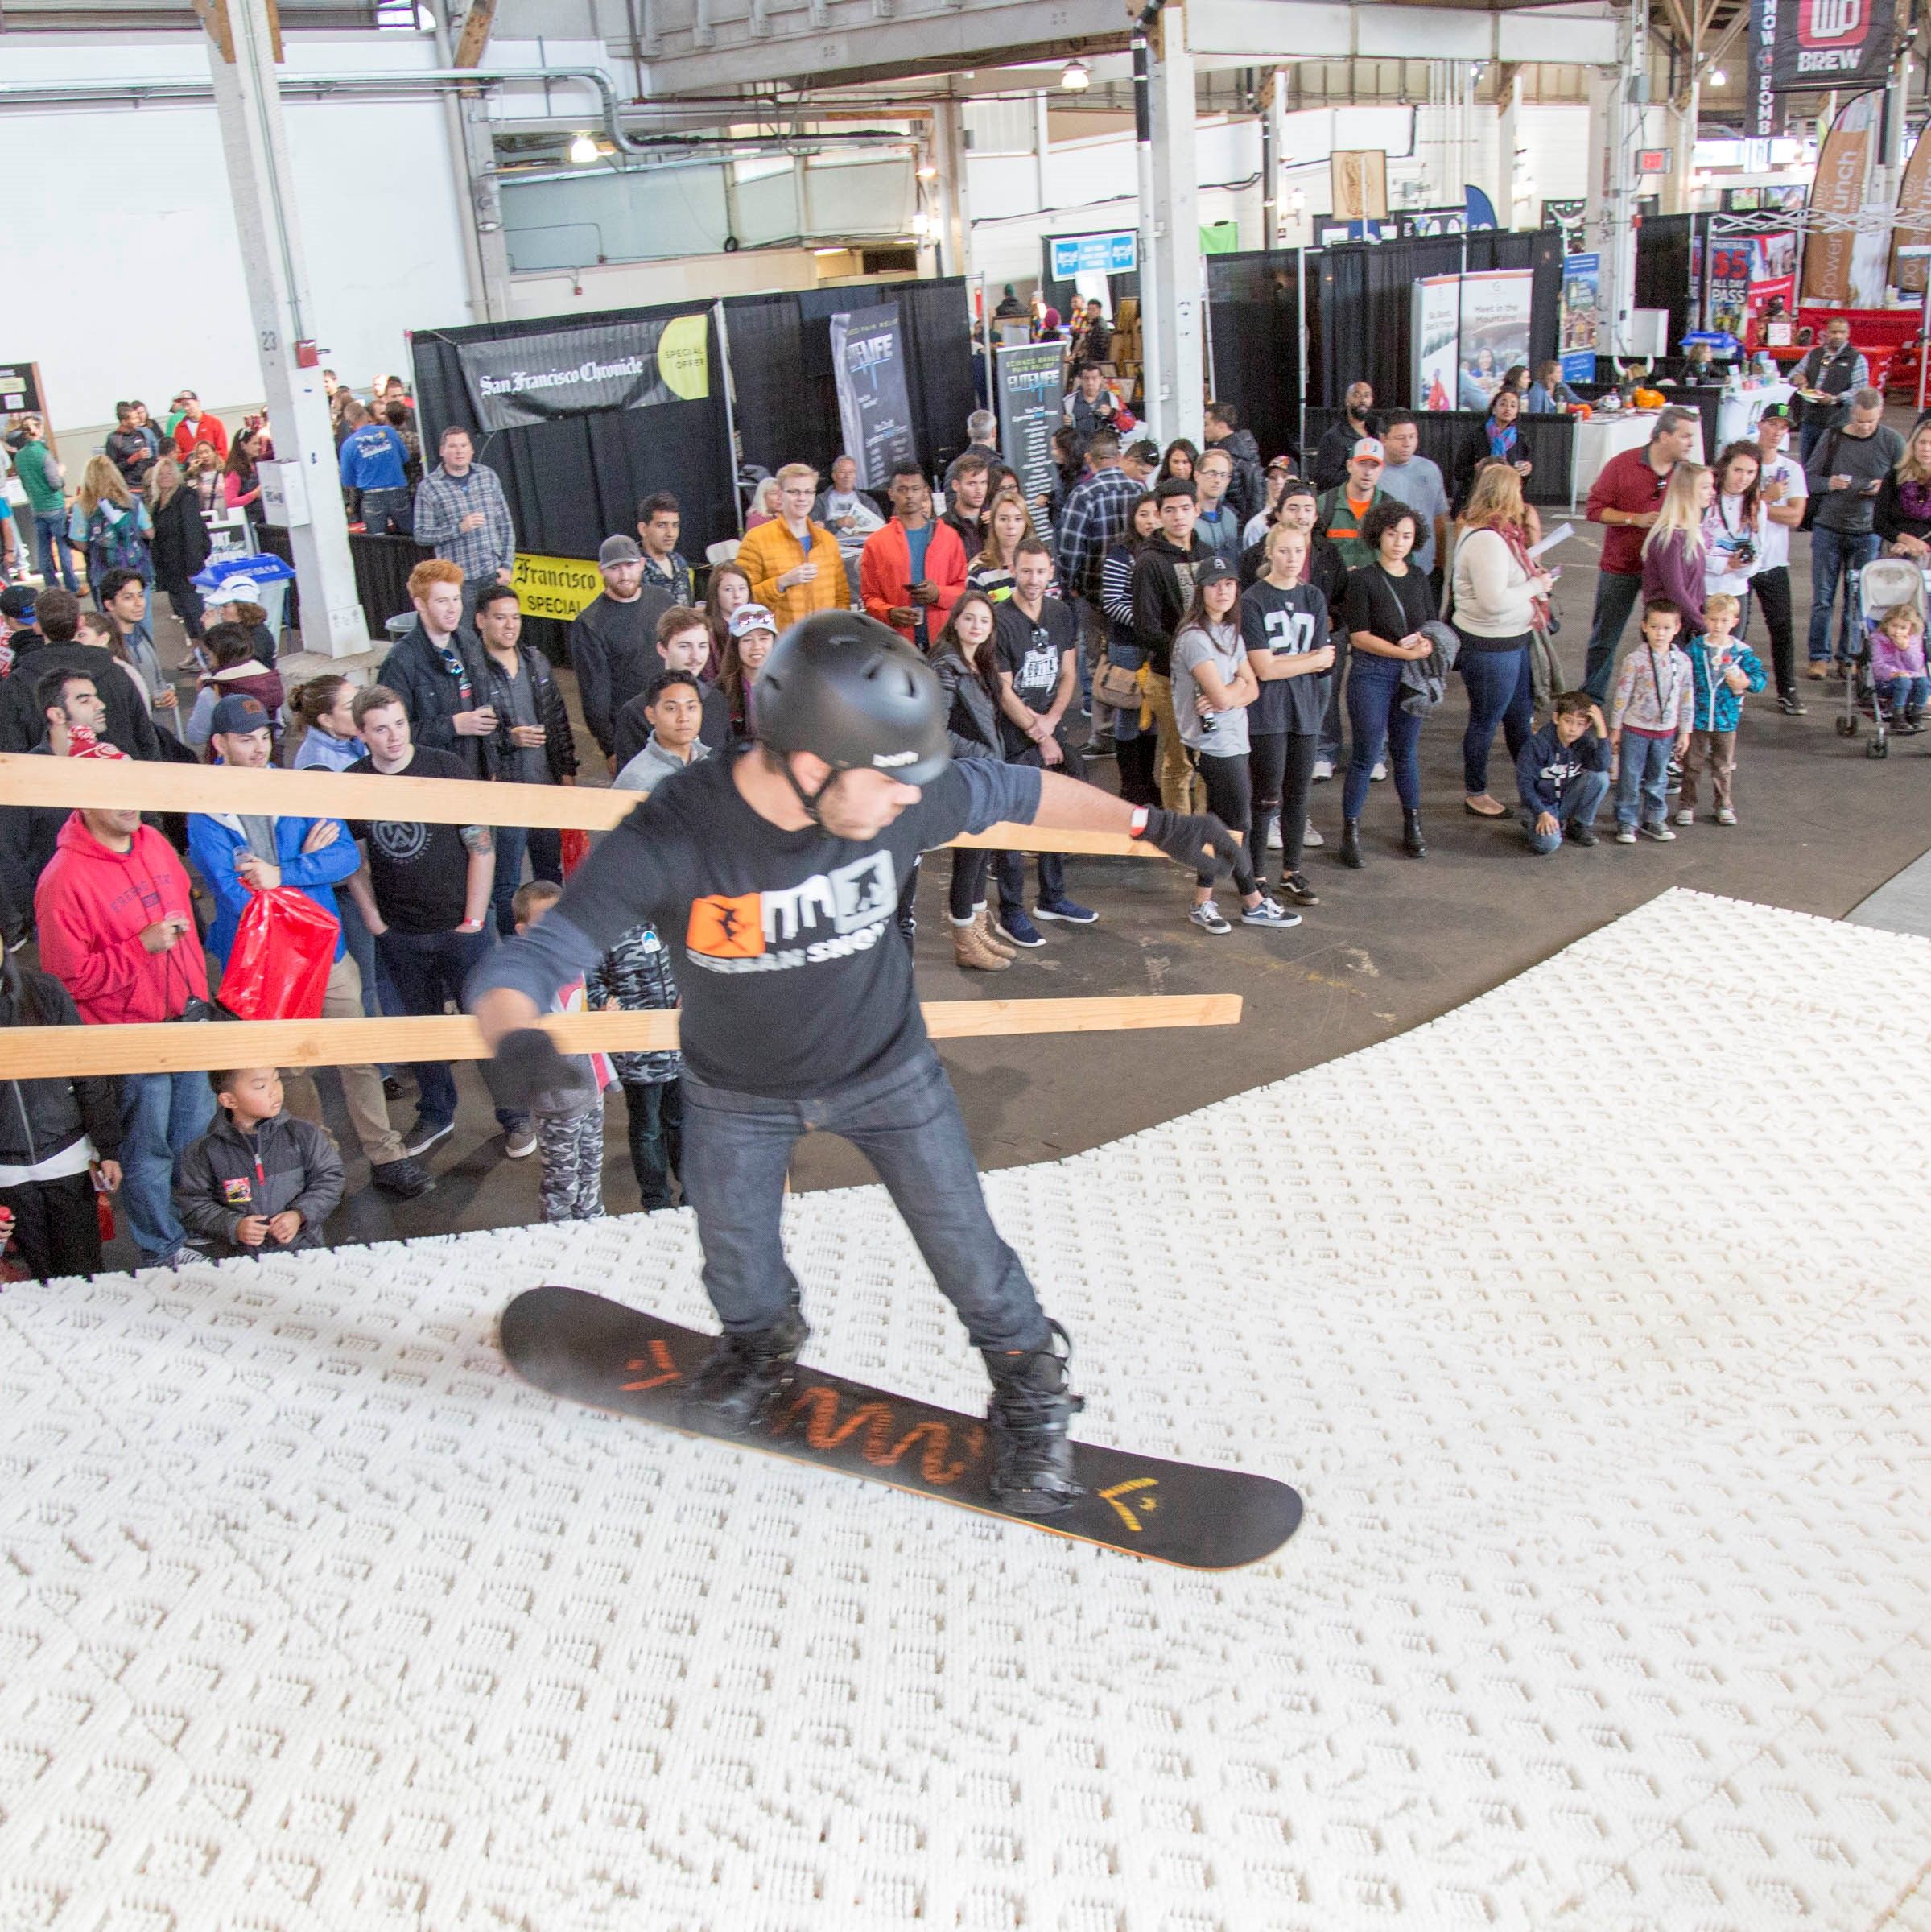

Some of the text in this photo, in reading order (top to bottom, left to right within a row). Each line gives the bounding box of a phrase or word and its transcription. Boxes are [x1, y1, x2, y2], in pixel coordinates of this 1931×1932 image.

[1797, 48, 1863, 72] BREW
[1758, 75, 1774, 135] BOMB
[1712, 250, 1749, 279] $5
[1820, 233, 1843, 298] power
[1711, 288, 1747, 303] PASS
[1712, 279, 1727, 289] ALL
[1729, 279, 1747, 289] DAY
[1474, 305, 1495, 314] Meet
[1496, 305, 1504, 313] in
[1475, 313, 1518, 324] Mountains
[261, 330, 277, 352] 23
[664, 346, 705, 360] SPECIAL
[675, 358, 707, 370] OFFER
[479, 355, 644, 397] San Francisco Chronicle
[514, 556, 596, 590] Francisco
[1263, 610, 1315, 655] 20
